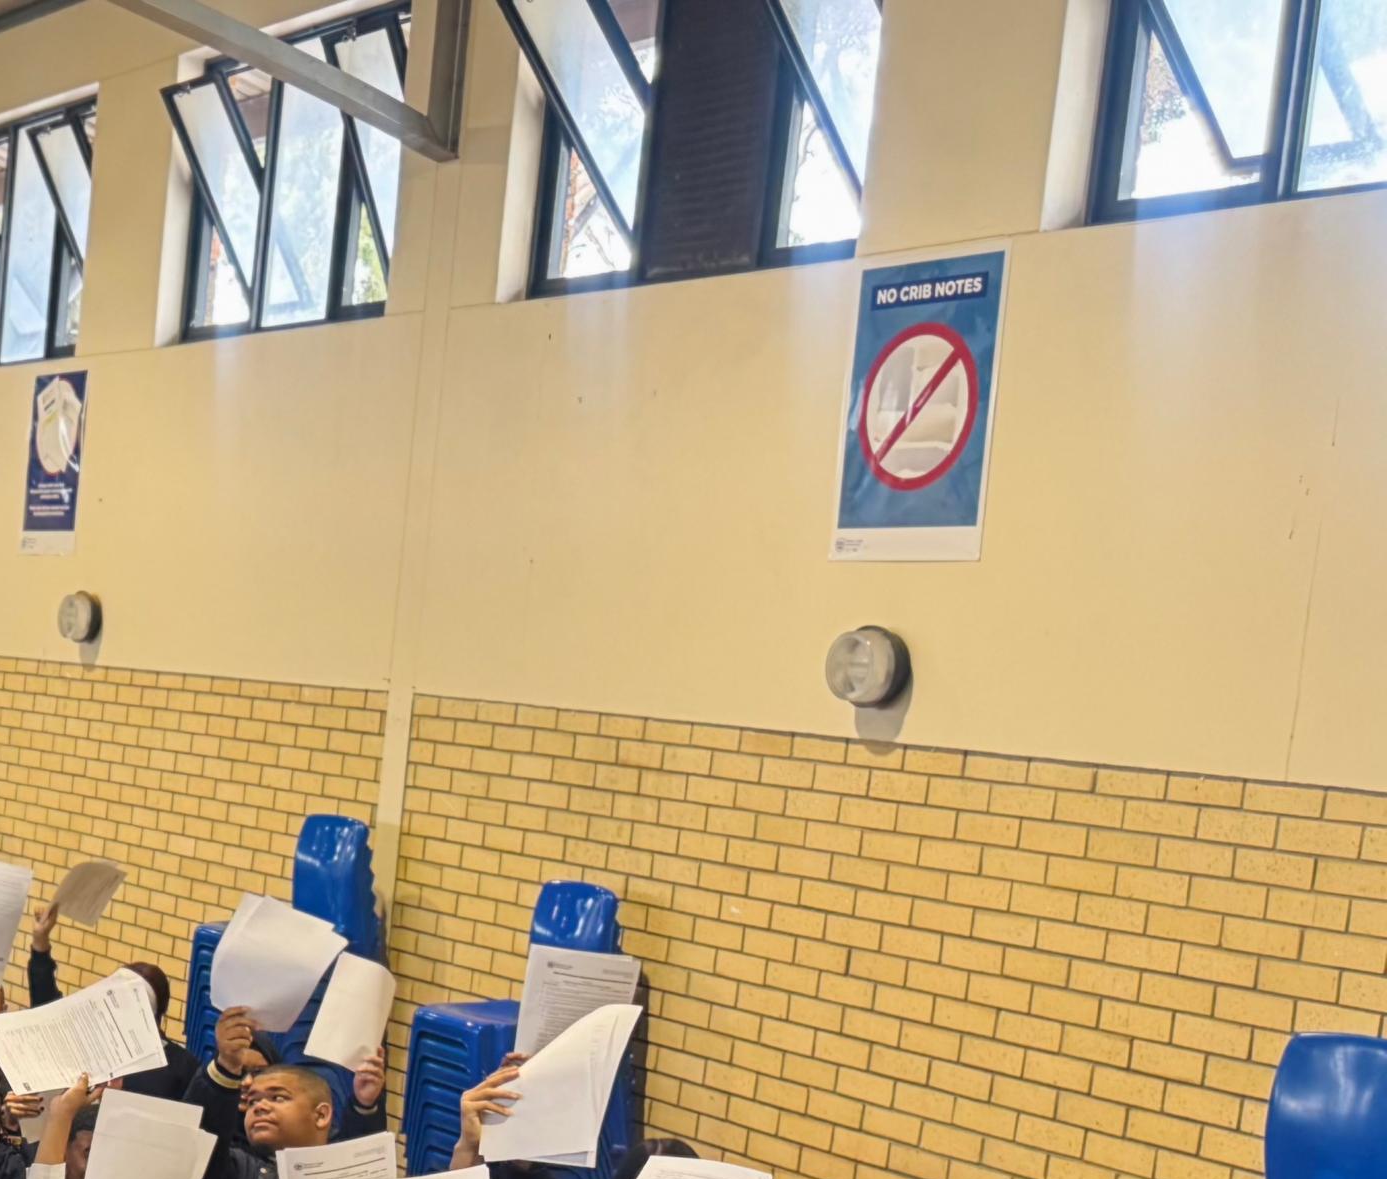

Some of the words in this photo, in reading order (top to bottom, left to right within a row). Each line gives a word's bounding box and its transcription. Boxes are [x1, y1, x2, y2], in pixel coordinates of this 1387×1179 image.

[877, 287, 897, 305] NO
[900, 283, 931, 302] CRIB
[935, 277, 983, 298] NOTES
